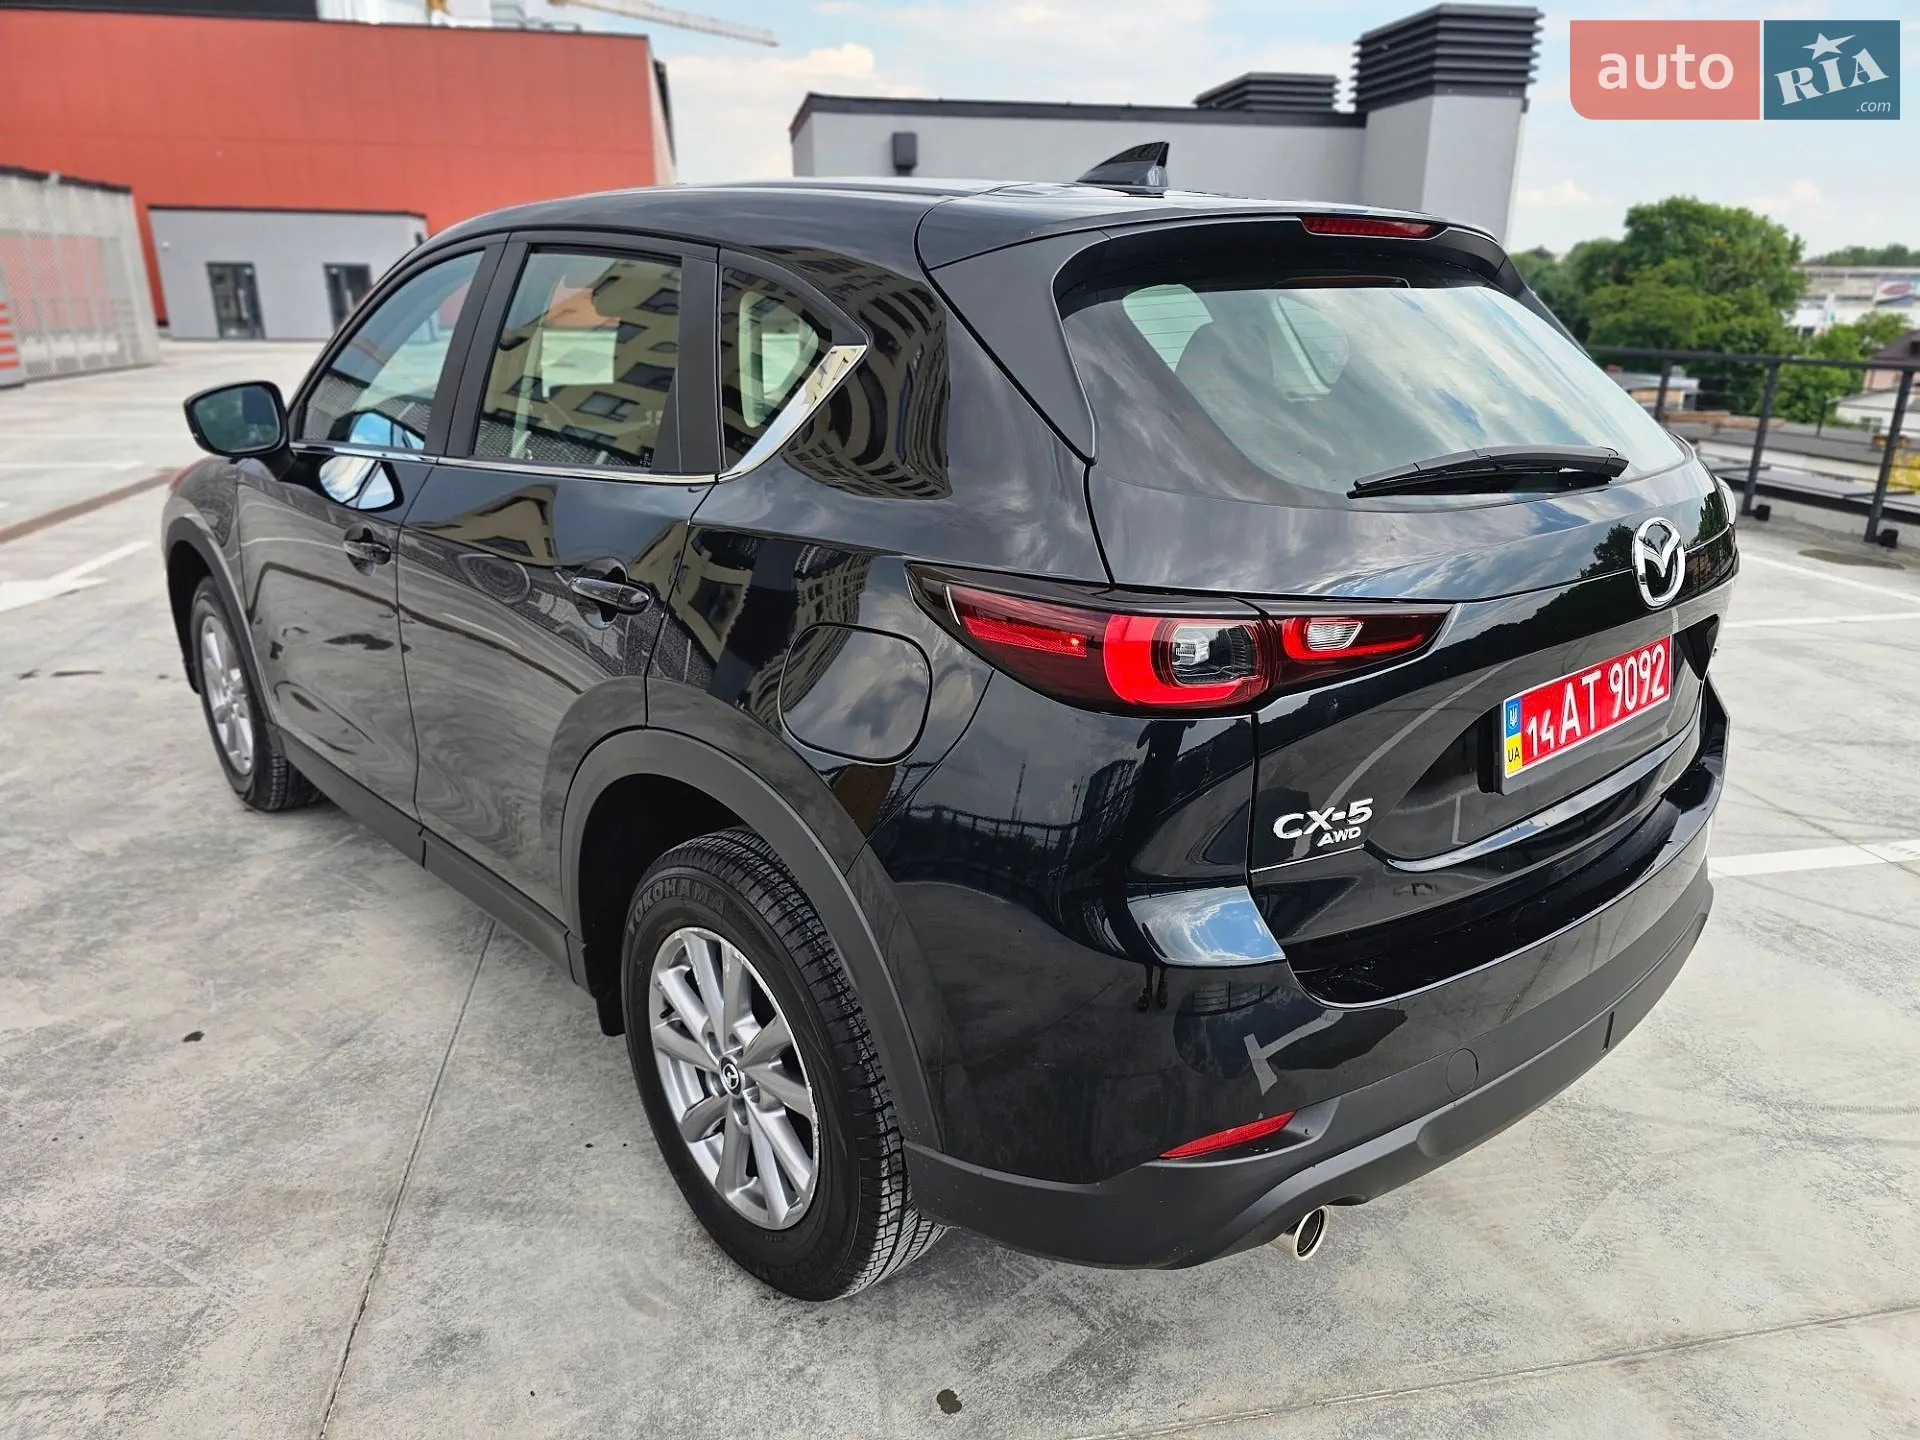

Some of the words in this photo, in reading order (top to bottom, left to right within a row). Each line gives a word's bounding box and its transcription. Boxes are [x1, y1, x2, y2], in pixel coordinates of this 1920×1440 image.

[1608, 643, 1666, 719] 9092
[1507, 747, 1521, 763] UA
[1273, 798, 1374, 839] CX-5
[1317, 826, 1361, 847] AWD
